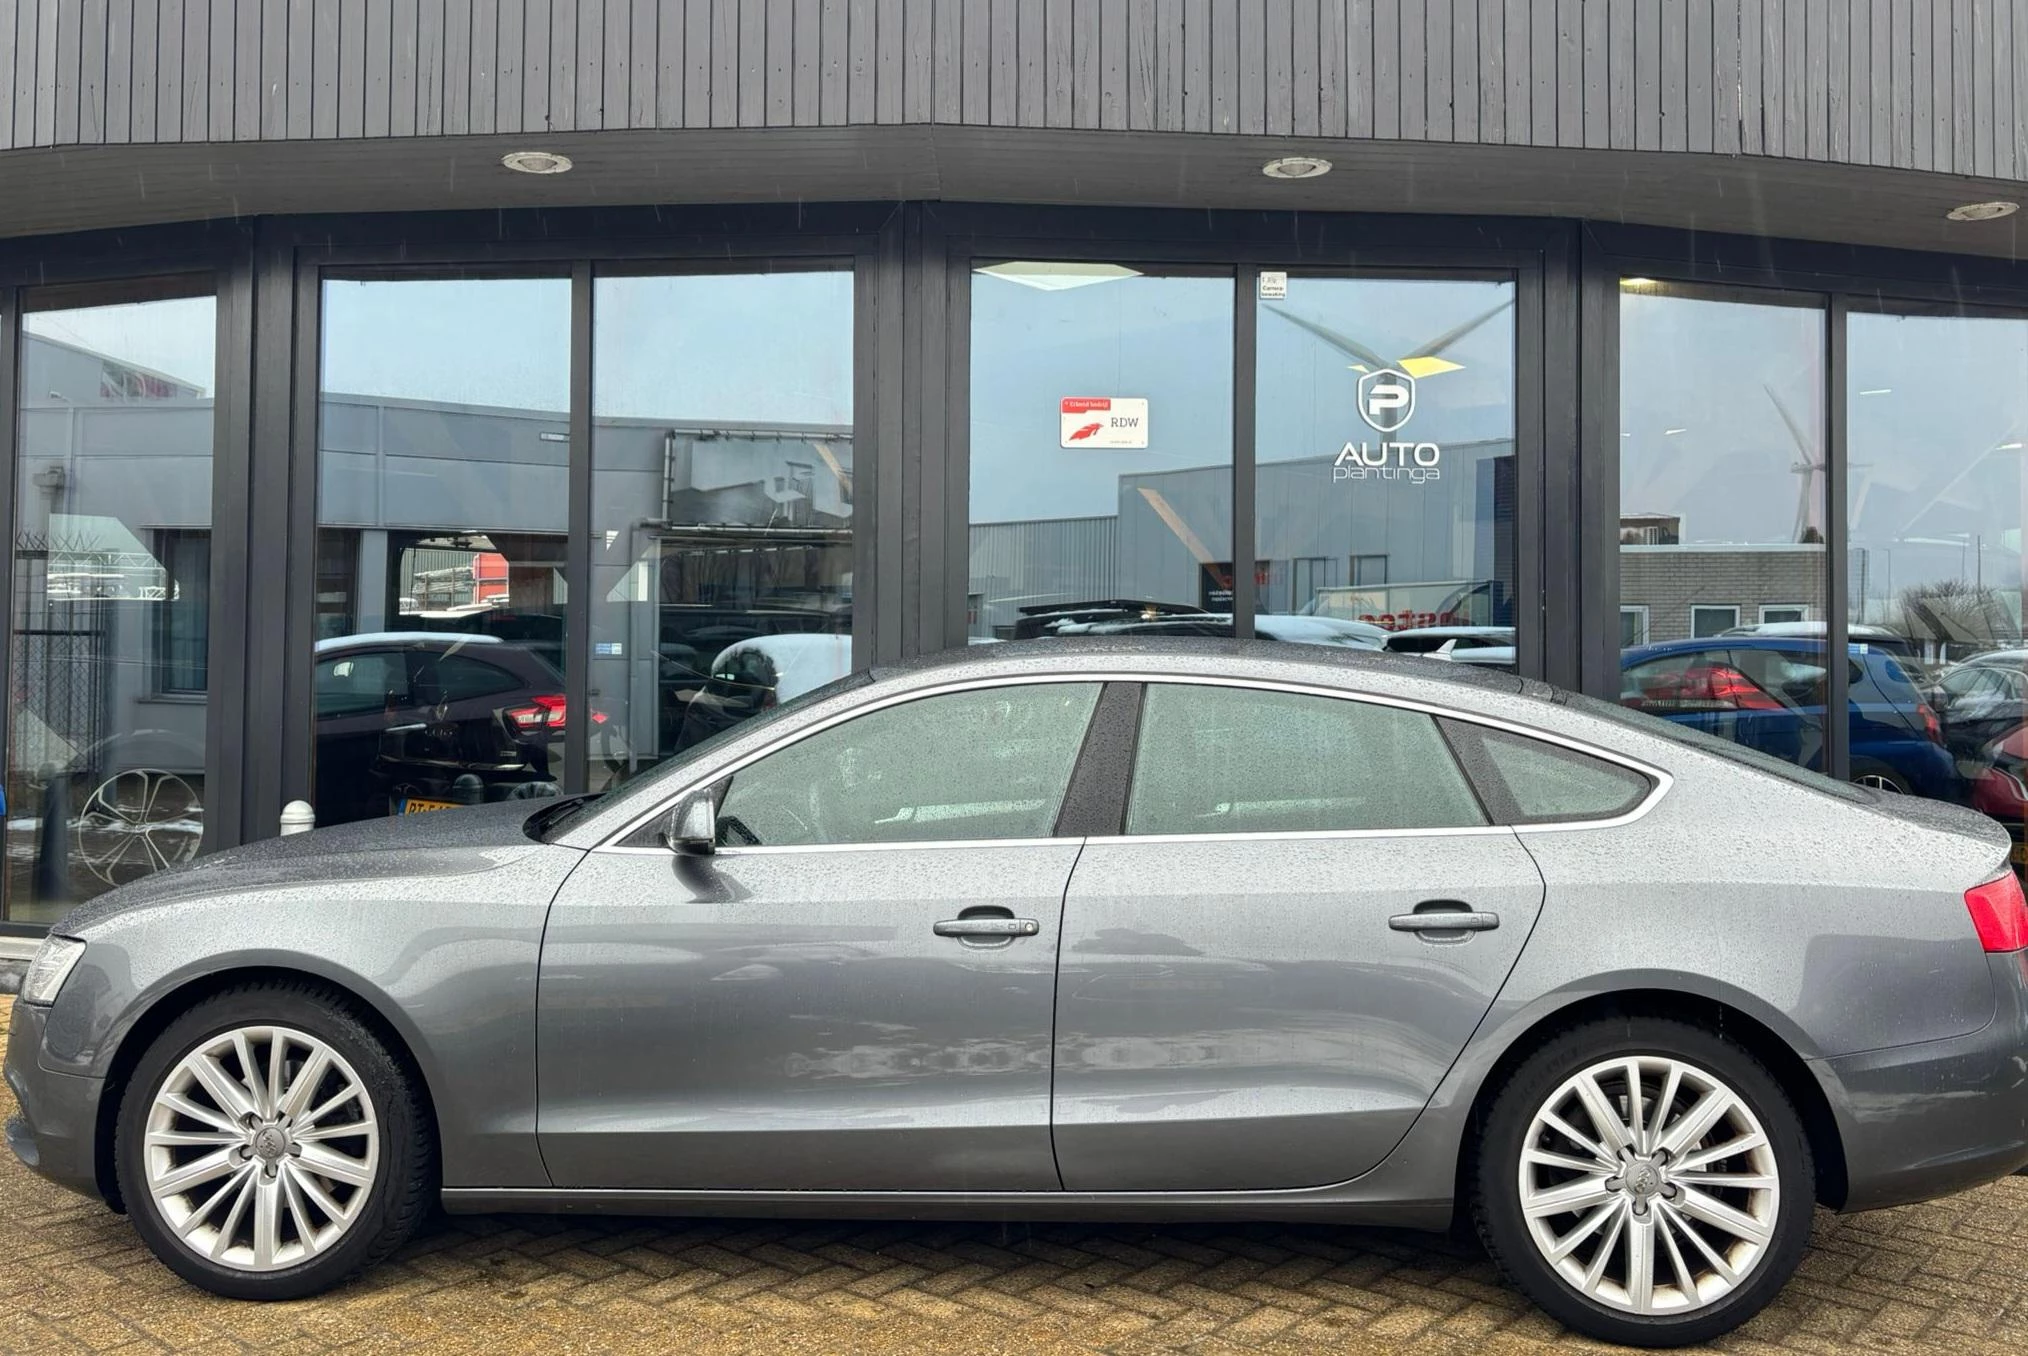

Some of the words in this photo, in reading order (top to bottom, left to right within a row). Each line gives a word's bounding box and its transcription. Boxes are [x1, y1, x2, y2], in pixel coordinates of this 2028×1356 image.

[1368, 384, 1410, 415] P
[1110, 417, 1139, 428] RDW
[1333, 442, 1440, 466] AUTO
[1333, 465, 1440, 484] plantinga
